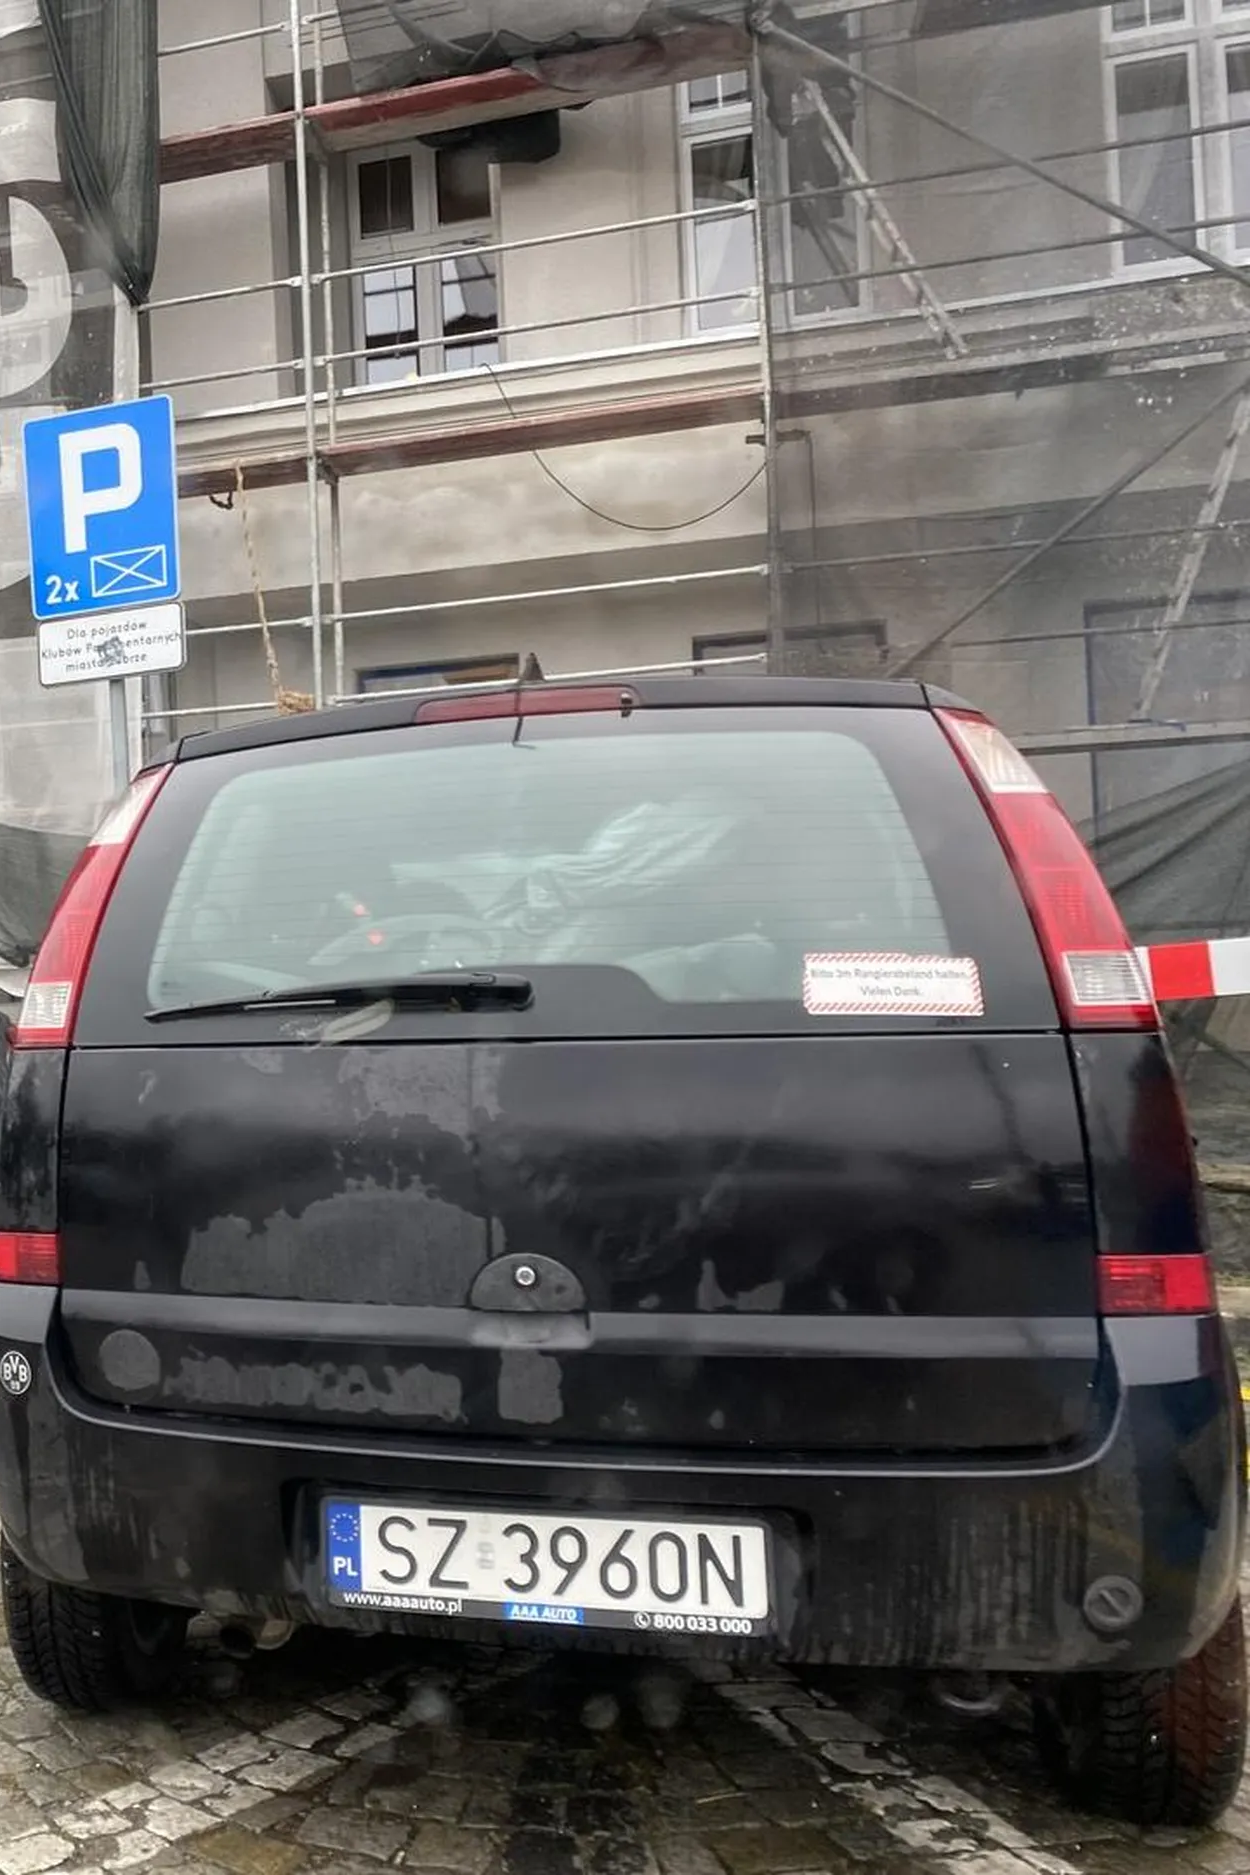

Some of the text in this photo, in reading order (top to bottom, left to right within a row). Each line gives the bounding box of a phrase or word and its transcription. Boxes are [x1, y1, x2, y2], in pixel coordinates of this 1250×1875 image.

[58, 423, 142, 554] P
[45, 575, 81, 605] 2x
[67, 620, 148, 640] Dla pojazdów
[41, 632, 182, 659] Klubów Paentarnych
[3, 1355, 27, 1383] BVB
[333, 1556, 359, 1577] PL
[377, 1515, 746, 1609] SZ 3960N
[343, 1591, 463, 1616] www.aaaauto.pl
[511, 1604, 578, 1621] AAA AUTO
[653, 1614, 752, 1634] 800 033 000
